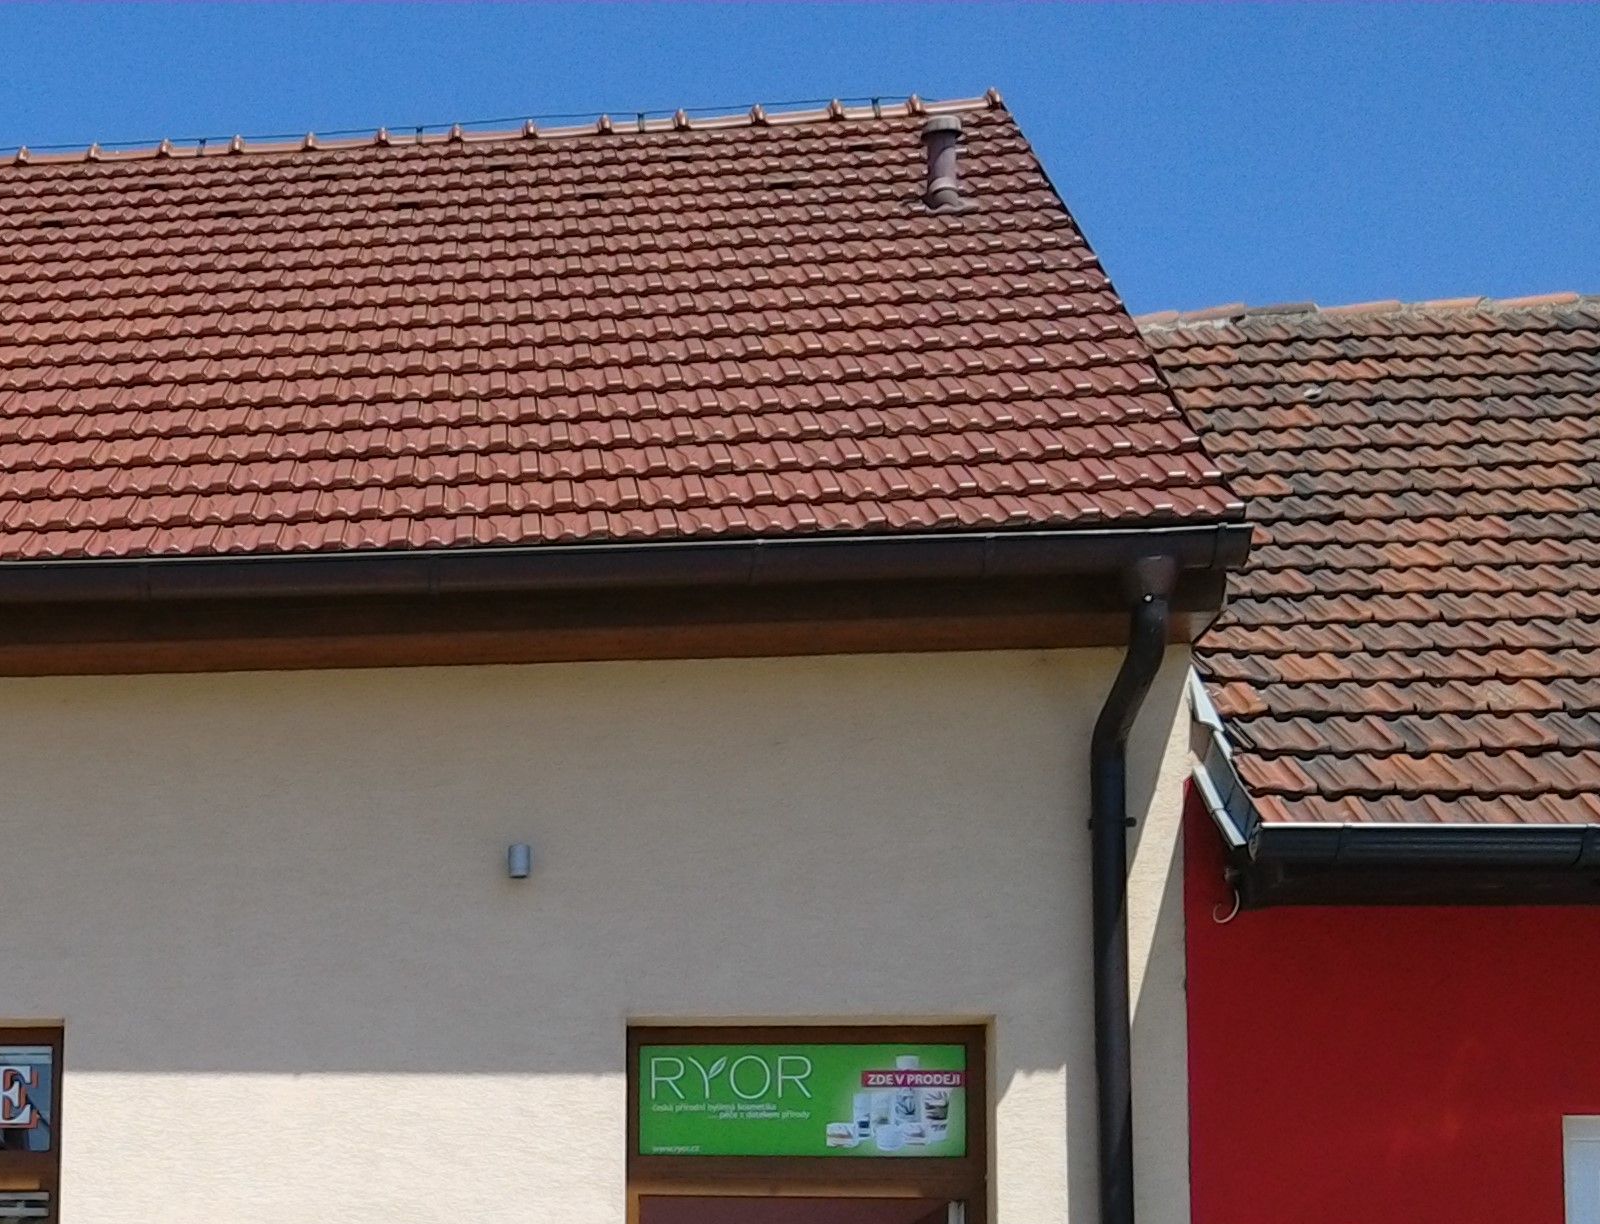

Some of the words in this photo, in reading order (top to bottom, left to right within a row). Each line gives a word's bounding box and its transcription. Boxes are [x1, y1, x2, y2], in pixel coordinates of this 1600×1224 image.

[651, 1055, 813, 1100] RYOR
[867, 1073, 894, 1085] ZDE
[895, 1073, 907, 1085] V
